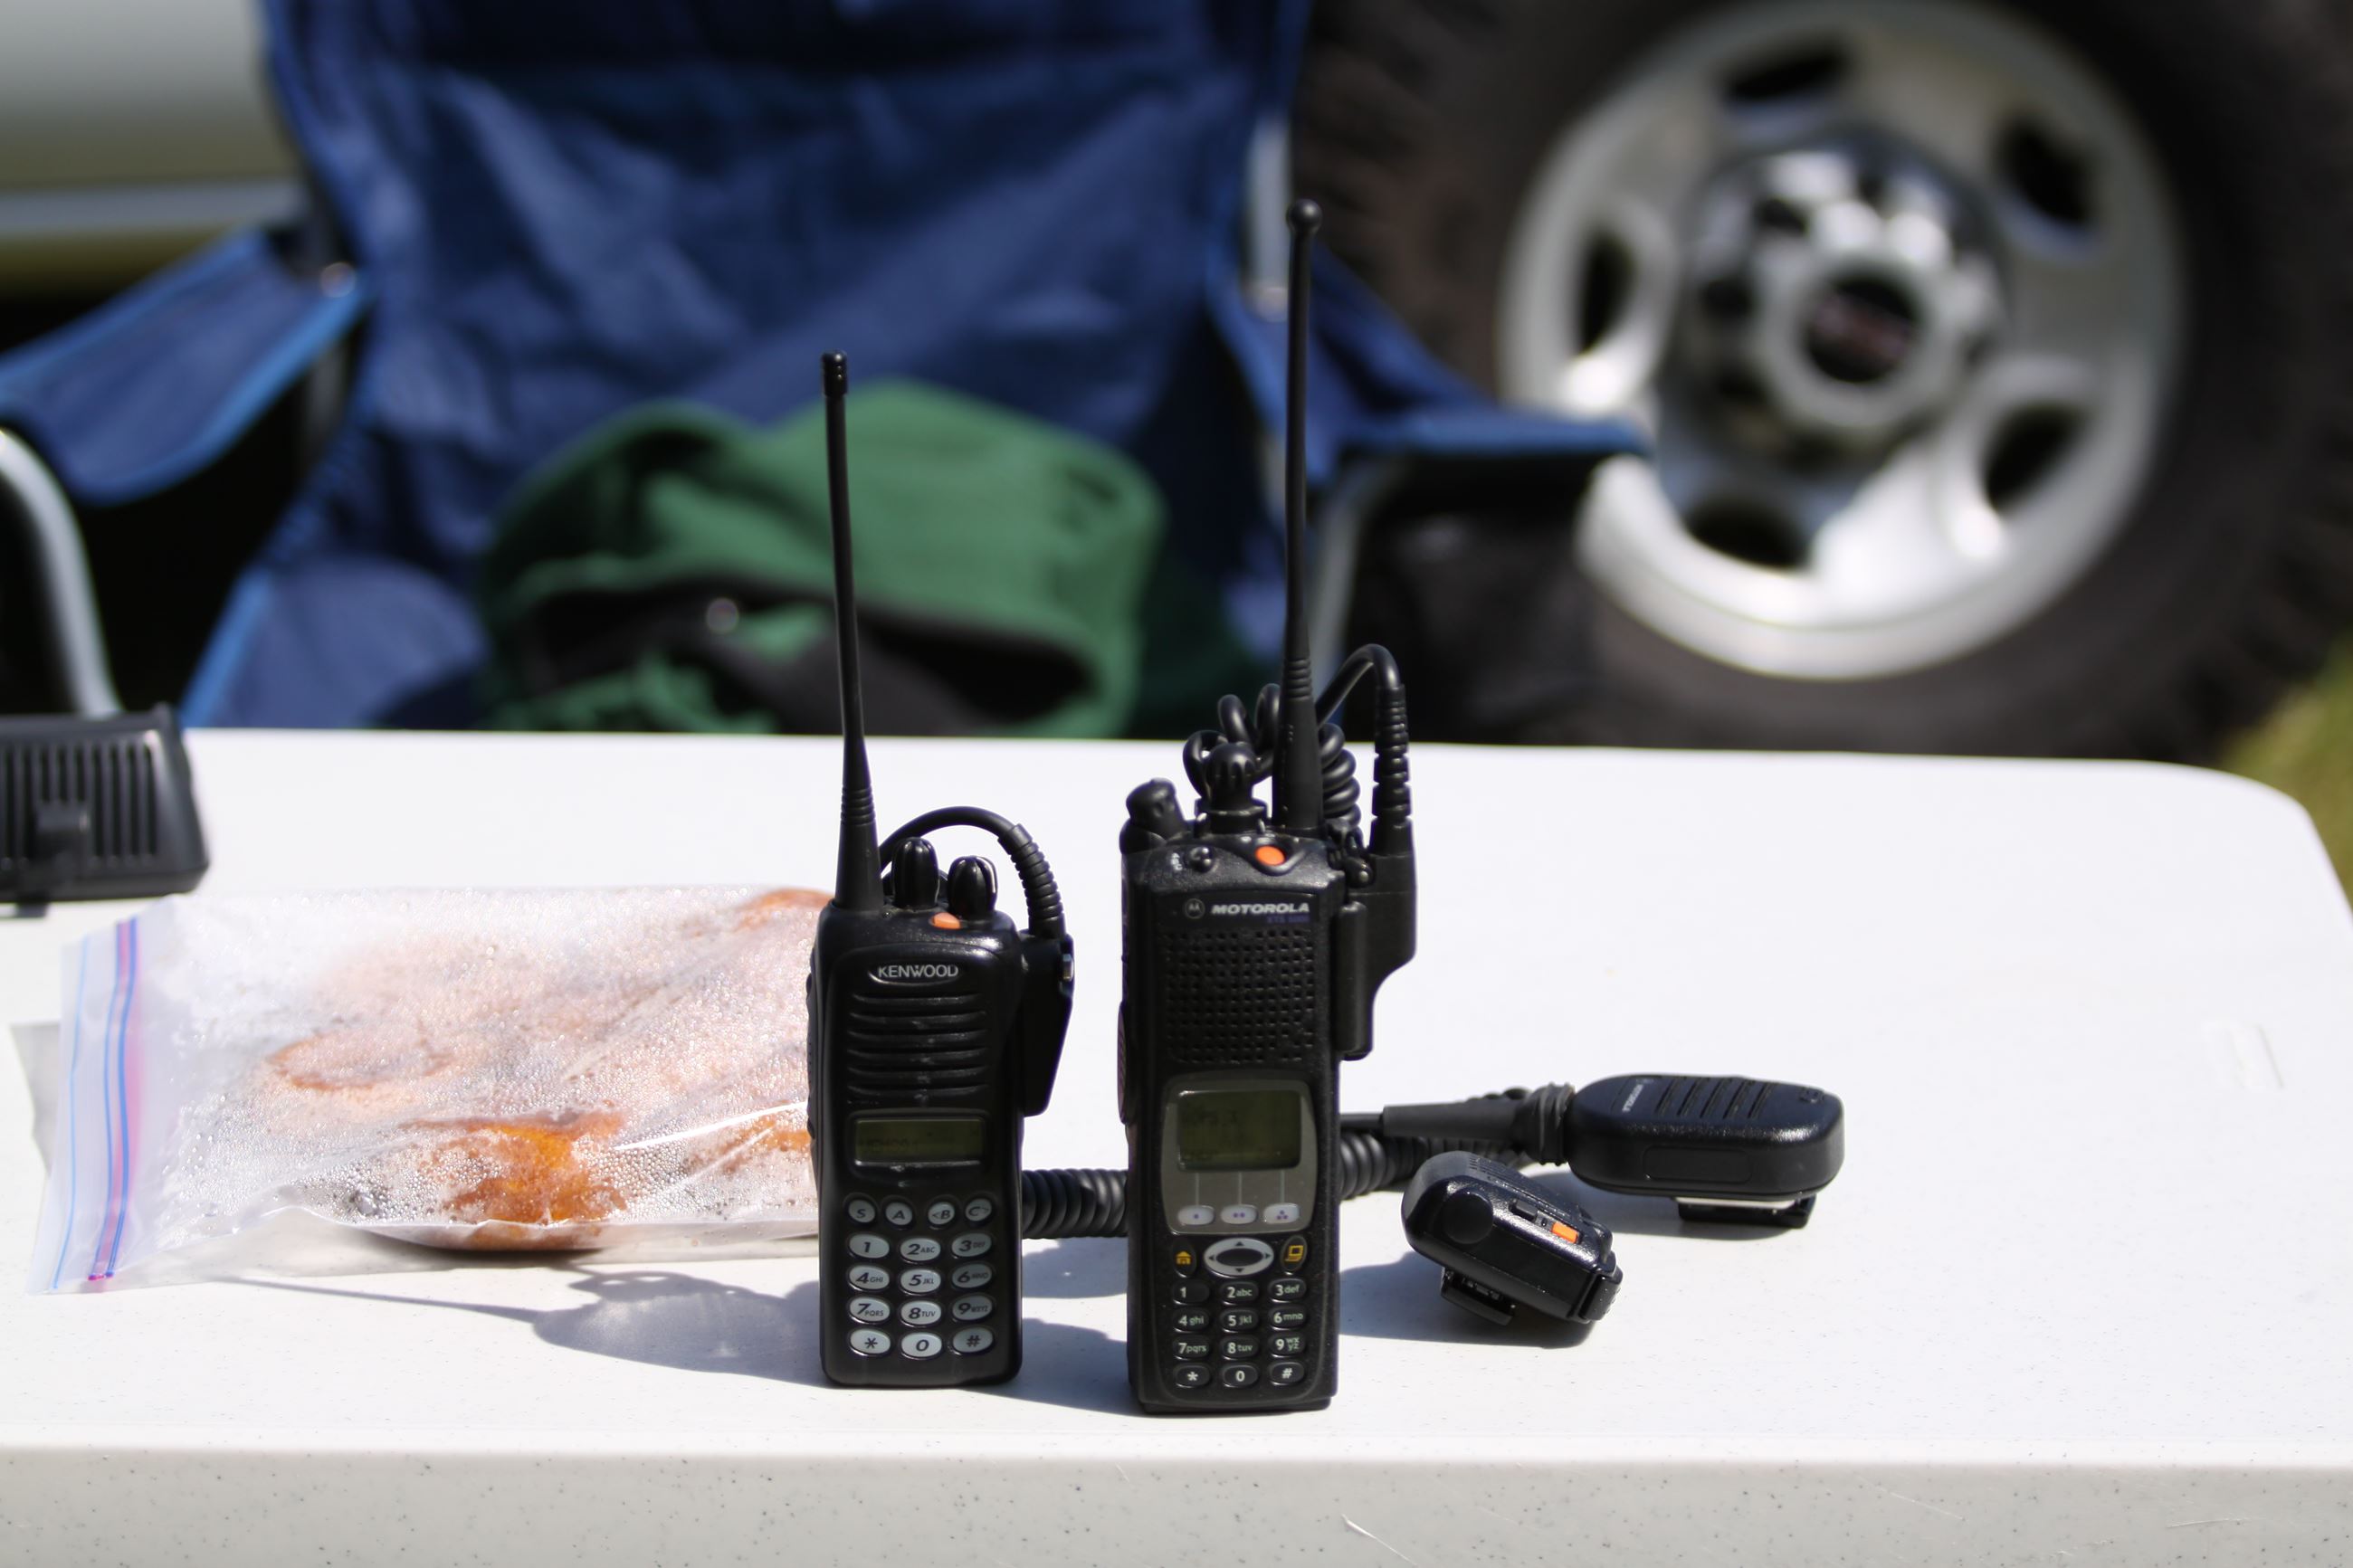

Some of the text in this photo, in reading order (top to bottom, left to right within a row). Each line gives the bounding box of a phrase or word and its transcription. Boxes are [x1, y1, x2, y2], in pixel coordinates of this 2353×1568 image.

[1211, 902, 1310, 915] MOTOROLA
[878, 965, 959, 977] KENWOOD
[856, 1208, 867, 1219] S
[891, 1209, 906, 1220] A
[863, 1241, 871, 1253] 1
[1179, 1288, 1186, 1298] 1
[967, 1335, 981, 1347] #
[1235, 1371, 1245, 1382] 0
[1281, 1367, 1293, 1379] #
